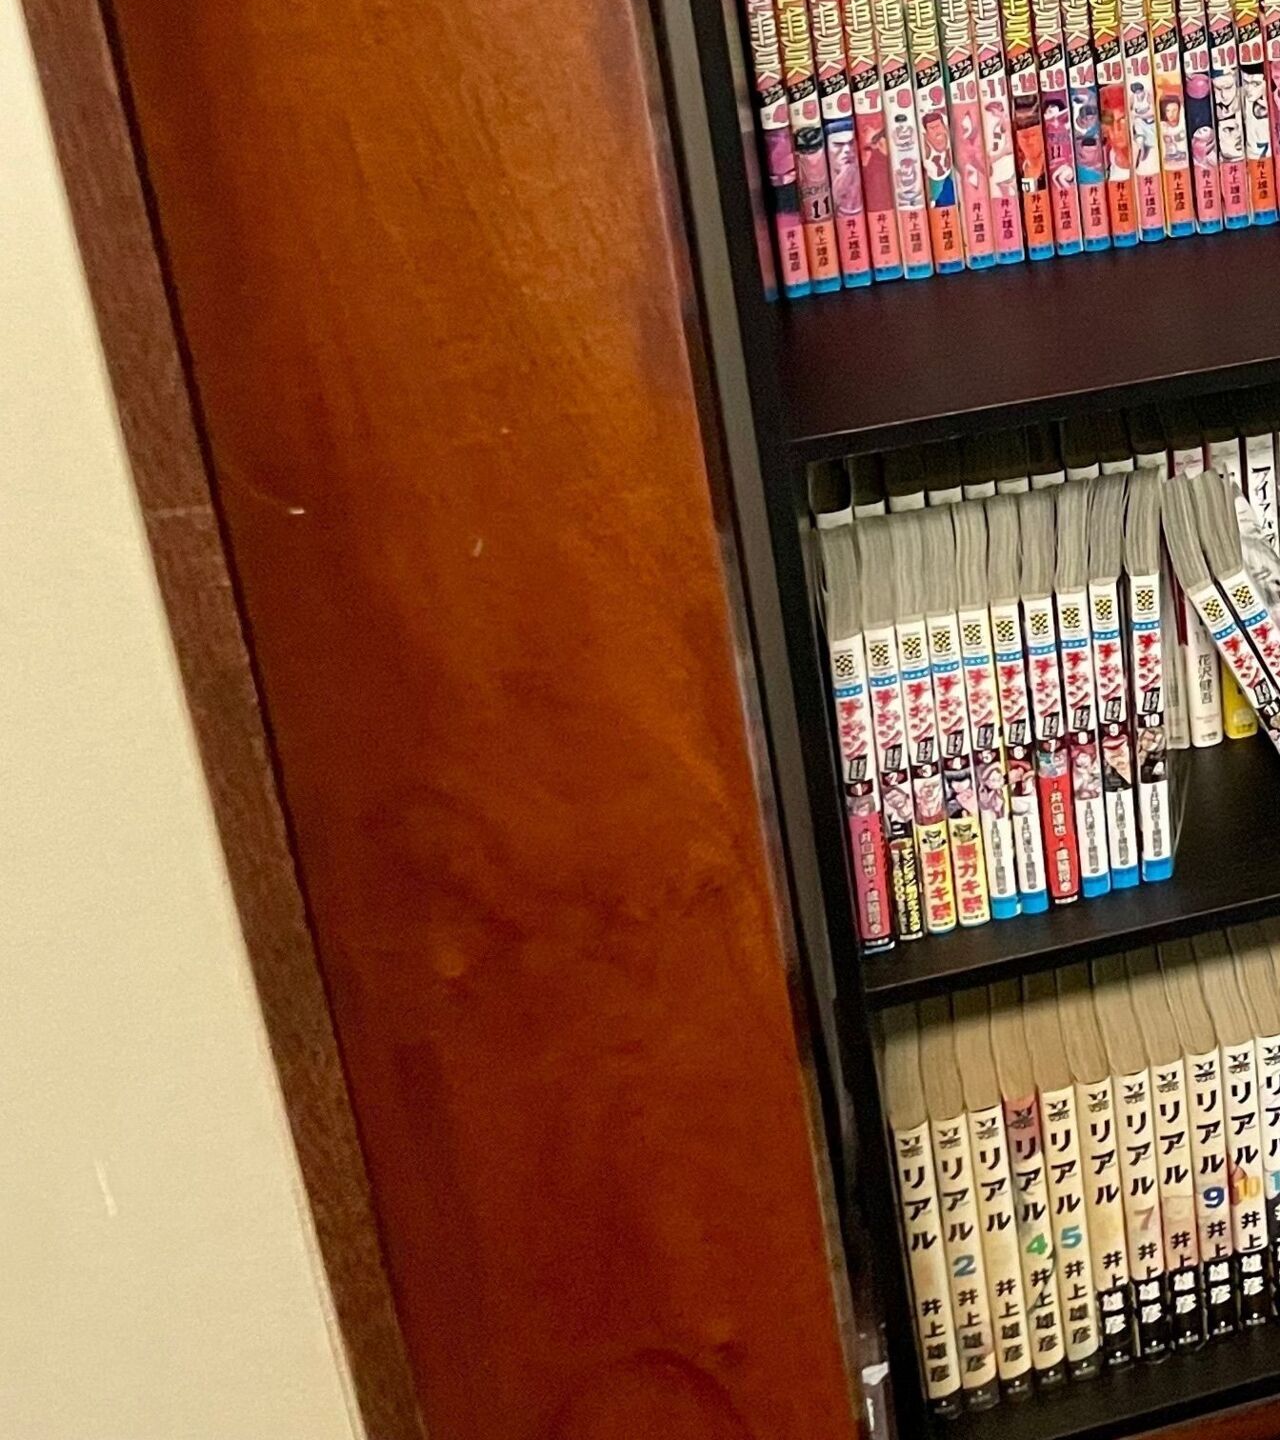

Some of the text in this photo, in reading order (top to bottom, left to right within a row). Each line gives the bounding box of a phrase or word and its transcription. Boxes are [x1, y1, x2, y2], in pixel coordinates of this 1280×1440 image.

[1144, 714, 1161, 728] 10
[1050, 1127, 1082, 1214] リアル
[1126, 1110, 1155, 1196] リアル
[1197, 1090, 1225, 1176] リアル
[902, 1166, 939, 1252] リアル
[940, 1157, 975, 1243] リアル
[979, 1146, 1012, 1233] リアル
[1202, 1186, 1225, 1209] 9
[952, 1253, 977, 1279] 2
[1025, 1233, 1049, 1255] 4
[1060, 1224, 1083, 1250] 5
